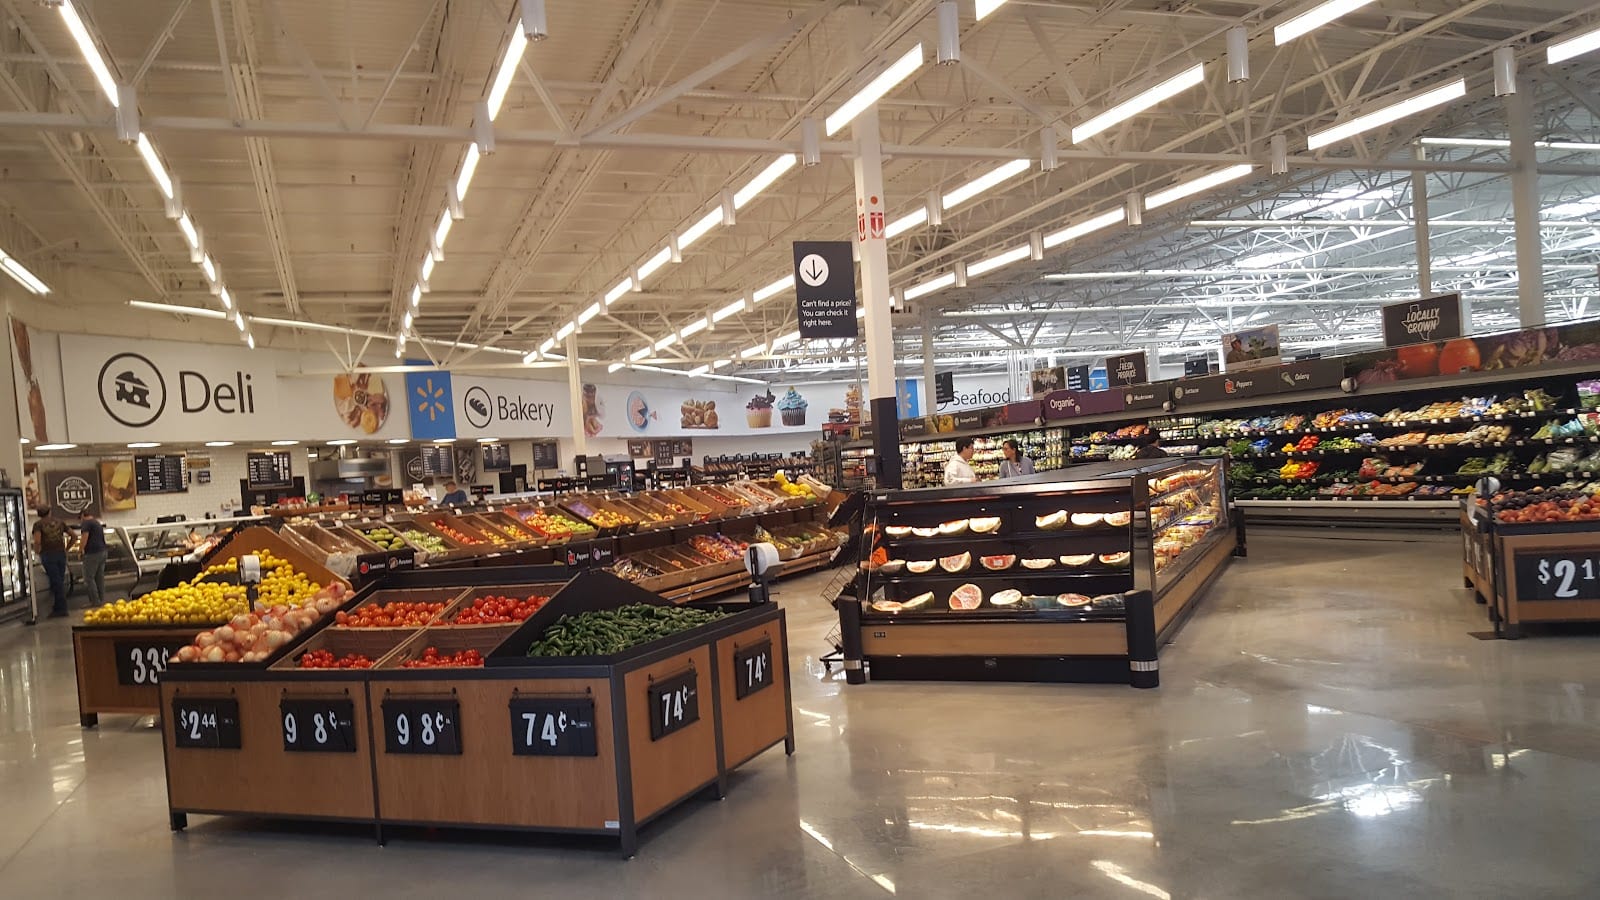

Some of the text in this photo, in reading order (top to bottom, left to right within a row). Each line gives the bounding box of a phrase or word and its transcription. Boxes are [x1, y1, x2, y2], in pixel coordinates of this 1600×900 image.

[802, 299, 817, 308] Can't
[818, 299, 830, 308] find
[835, 299, 852, 309] price?
[826, 309, 843, 317] check
[1406, 307, 1440, 322] LOCALLY
[803, 319, 817, 328] right
[1407, 319, 1437, 334] GROWN
[179, 371, 255, 413] Deli
[952, 387, 1011, 406] Seafood
[498, 395, 554, 427] Bakery
[1050, 397, 1075, 411] Organic
[63, 490, 86, 499] DELI
